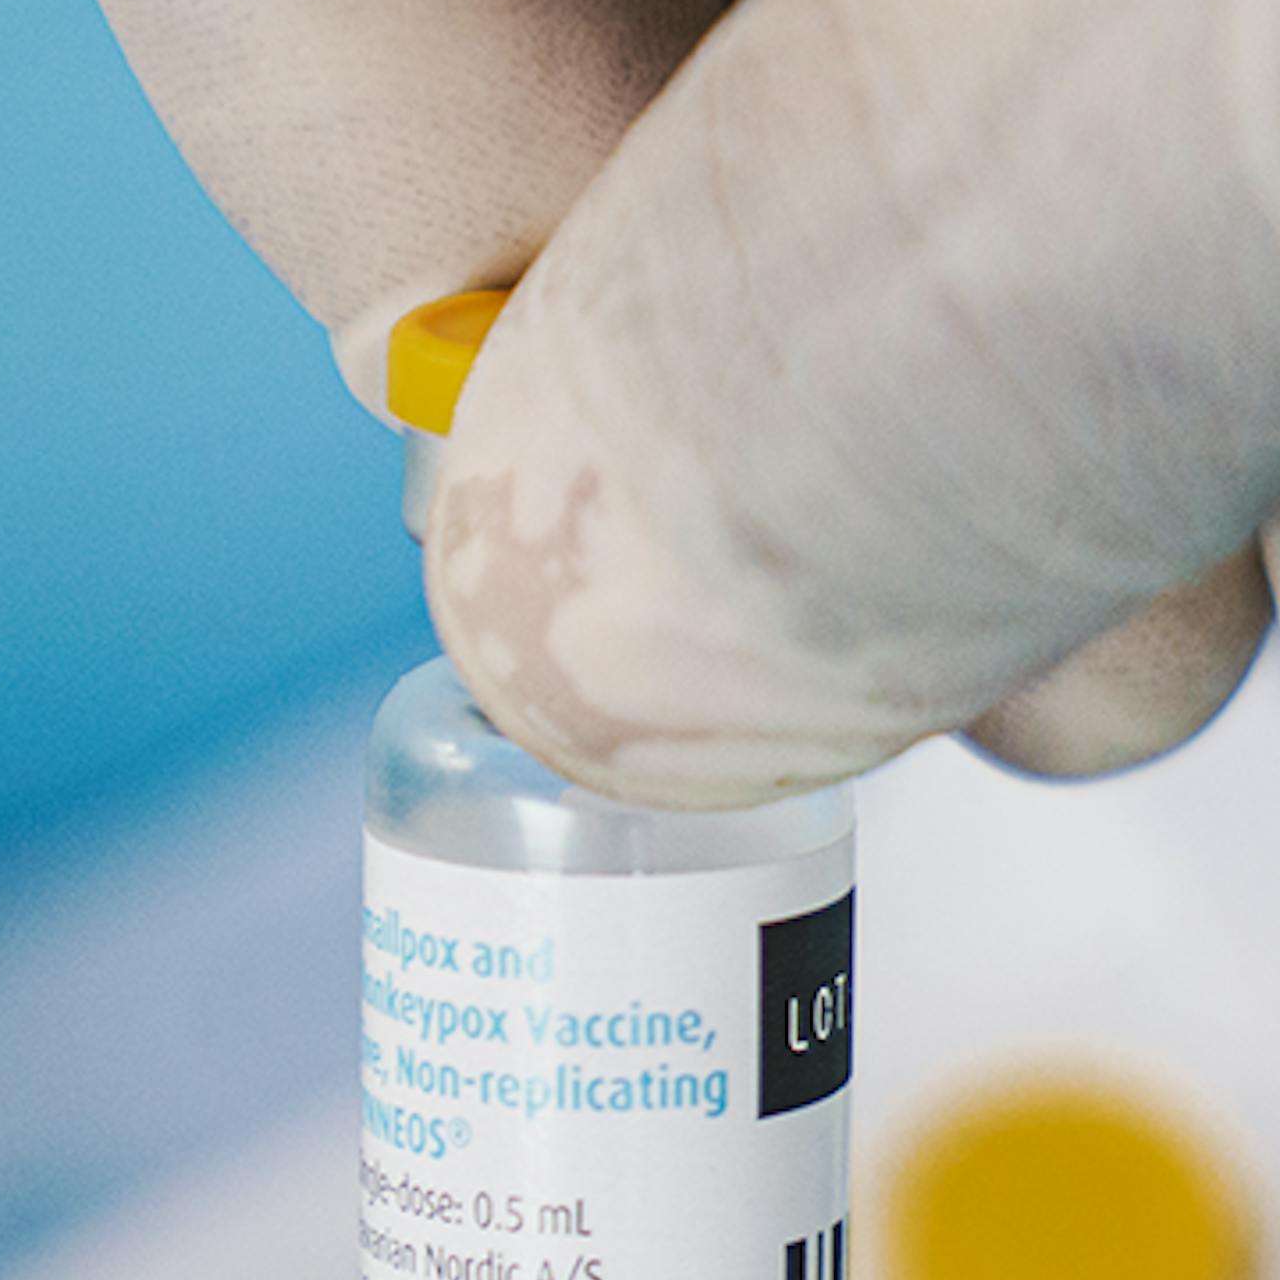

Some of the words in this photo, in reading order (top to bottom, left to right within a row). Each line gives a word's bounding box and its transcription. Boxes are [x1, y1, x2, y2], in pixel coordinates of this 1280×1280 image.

[473, 937, 555, 985] and
[524, 1000, 718, 1053] Vaccine,
[396, 1045, 729, 1119] Non-replicating
[362, 1086, 474, 1161] NNEOS®
[473, 1191, 524, 1234] 0.5
[538, 1198, 592, 1237] mL
